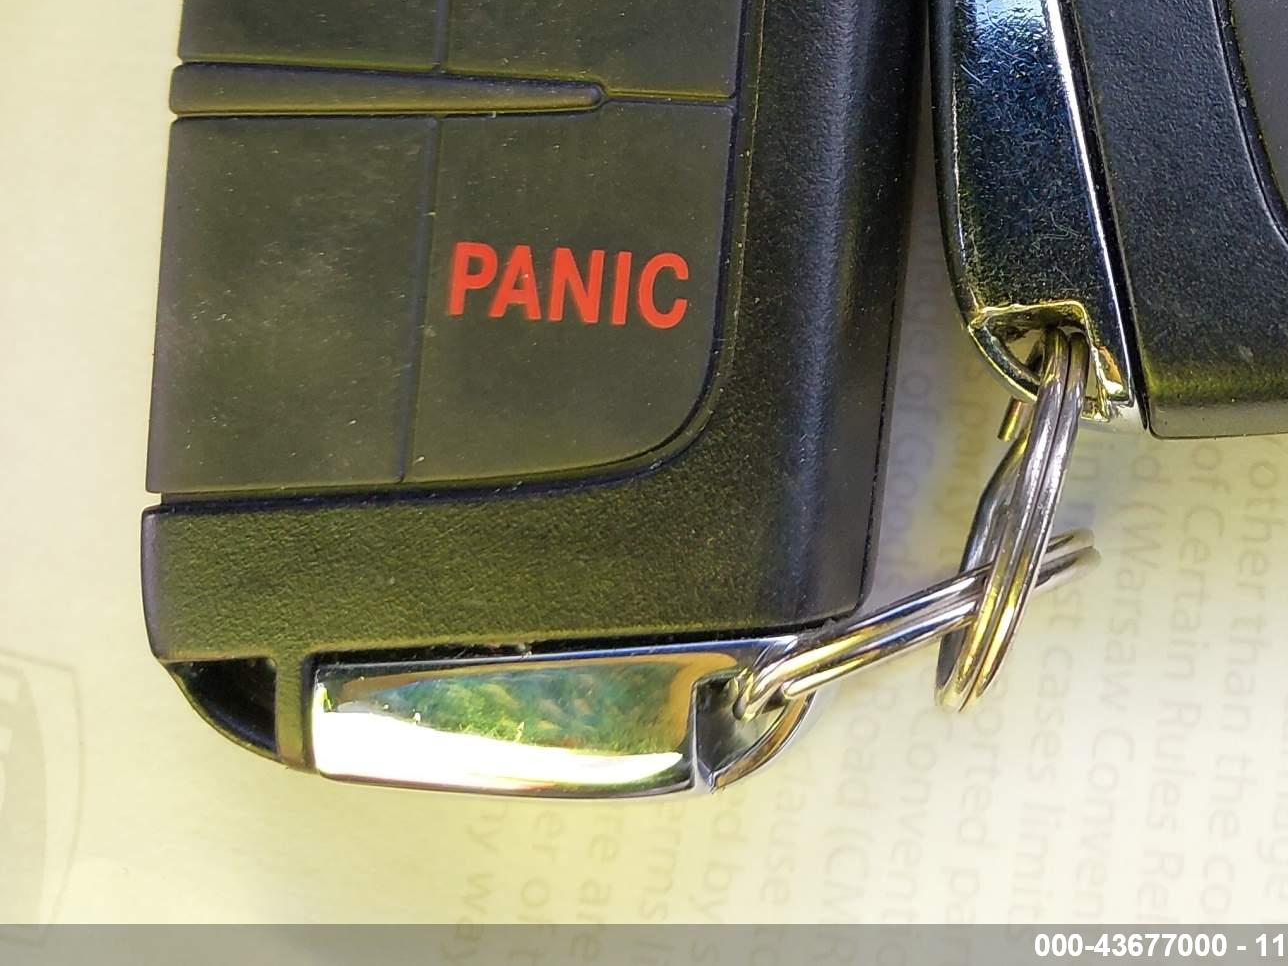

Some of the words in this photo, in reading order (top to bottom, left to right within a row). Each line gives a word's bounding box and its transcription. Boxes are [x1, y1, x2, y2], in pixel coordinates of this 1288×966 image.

[447, 241, 690, 331] PANIC
[1187, 445, 1231, 496] of
[1235, 460, 1286, 602] other
[1099, 500, 1168, 712] (Warsaw
[1163, 504, 1225, 682] Certain
[1026, 646, 1076, 785] cases
[1220, 613, 1273, 734] than
[1145, 698, 1203, 832] Rules
[1206, 752, 1259, 841] the
[688, 859, 747, 925] by
